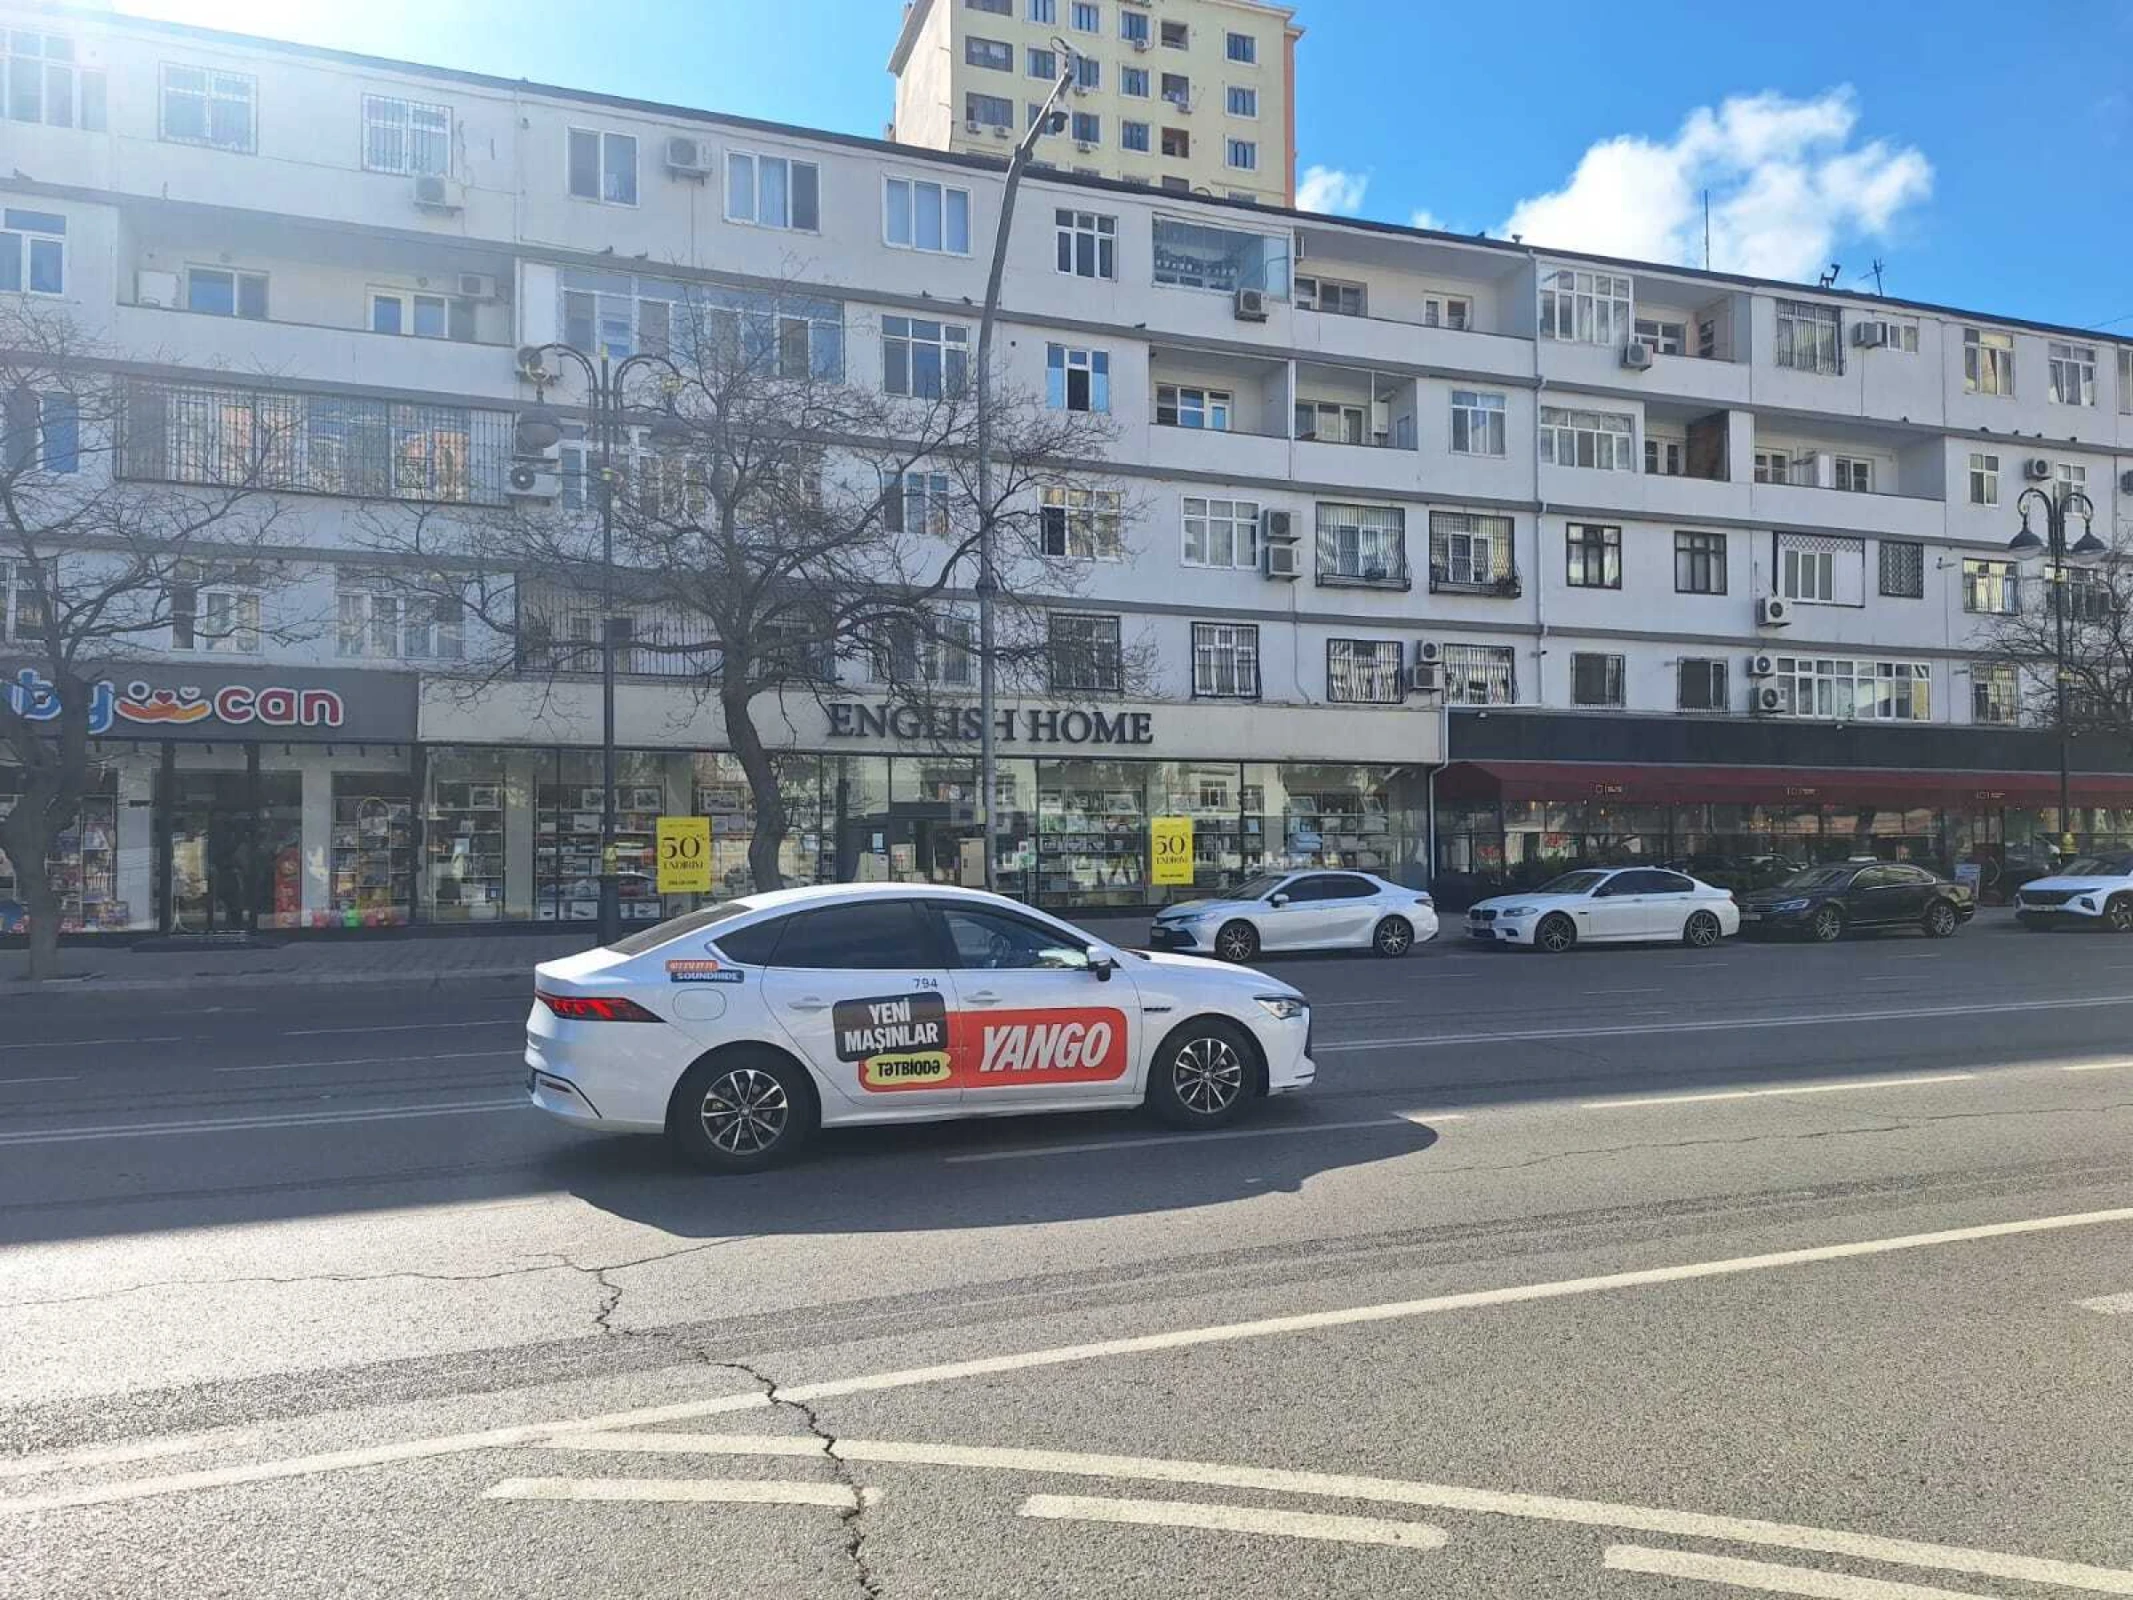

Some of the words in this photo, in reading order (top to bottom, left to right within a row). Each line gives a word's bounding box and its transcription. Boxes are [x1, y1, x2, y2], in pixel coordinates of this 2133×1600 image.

[214, 685, 344, 726] can
[827, 703, 1017, 741] ENGLISH
[1028, 709, 1153, 745] HOME
[913, 978, 938, 989] 794
[868, 997, 911, 1025] YENİ
[979, 1021, 1112, 1073] YANGO
